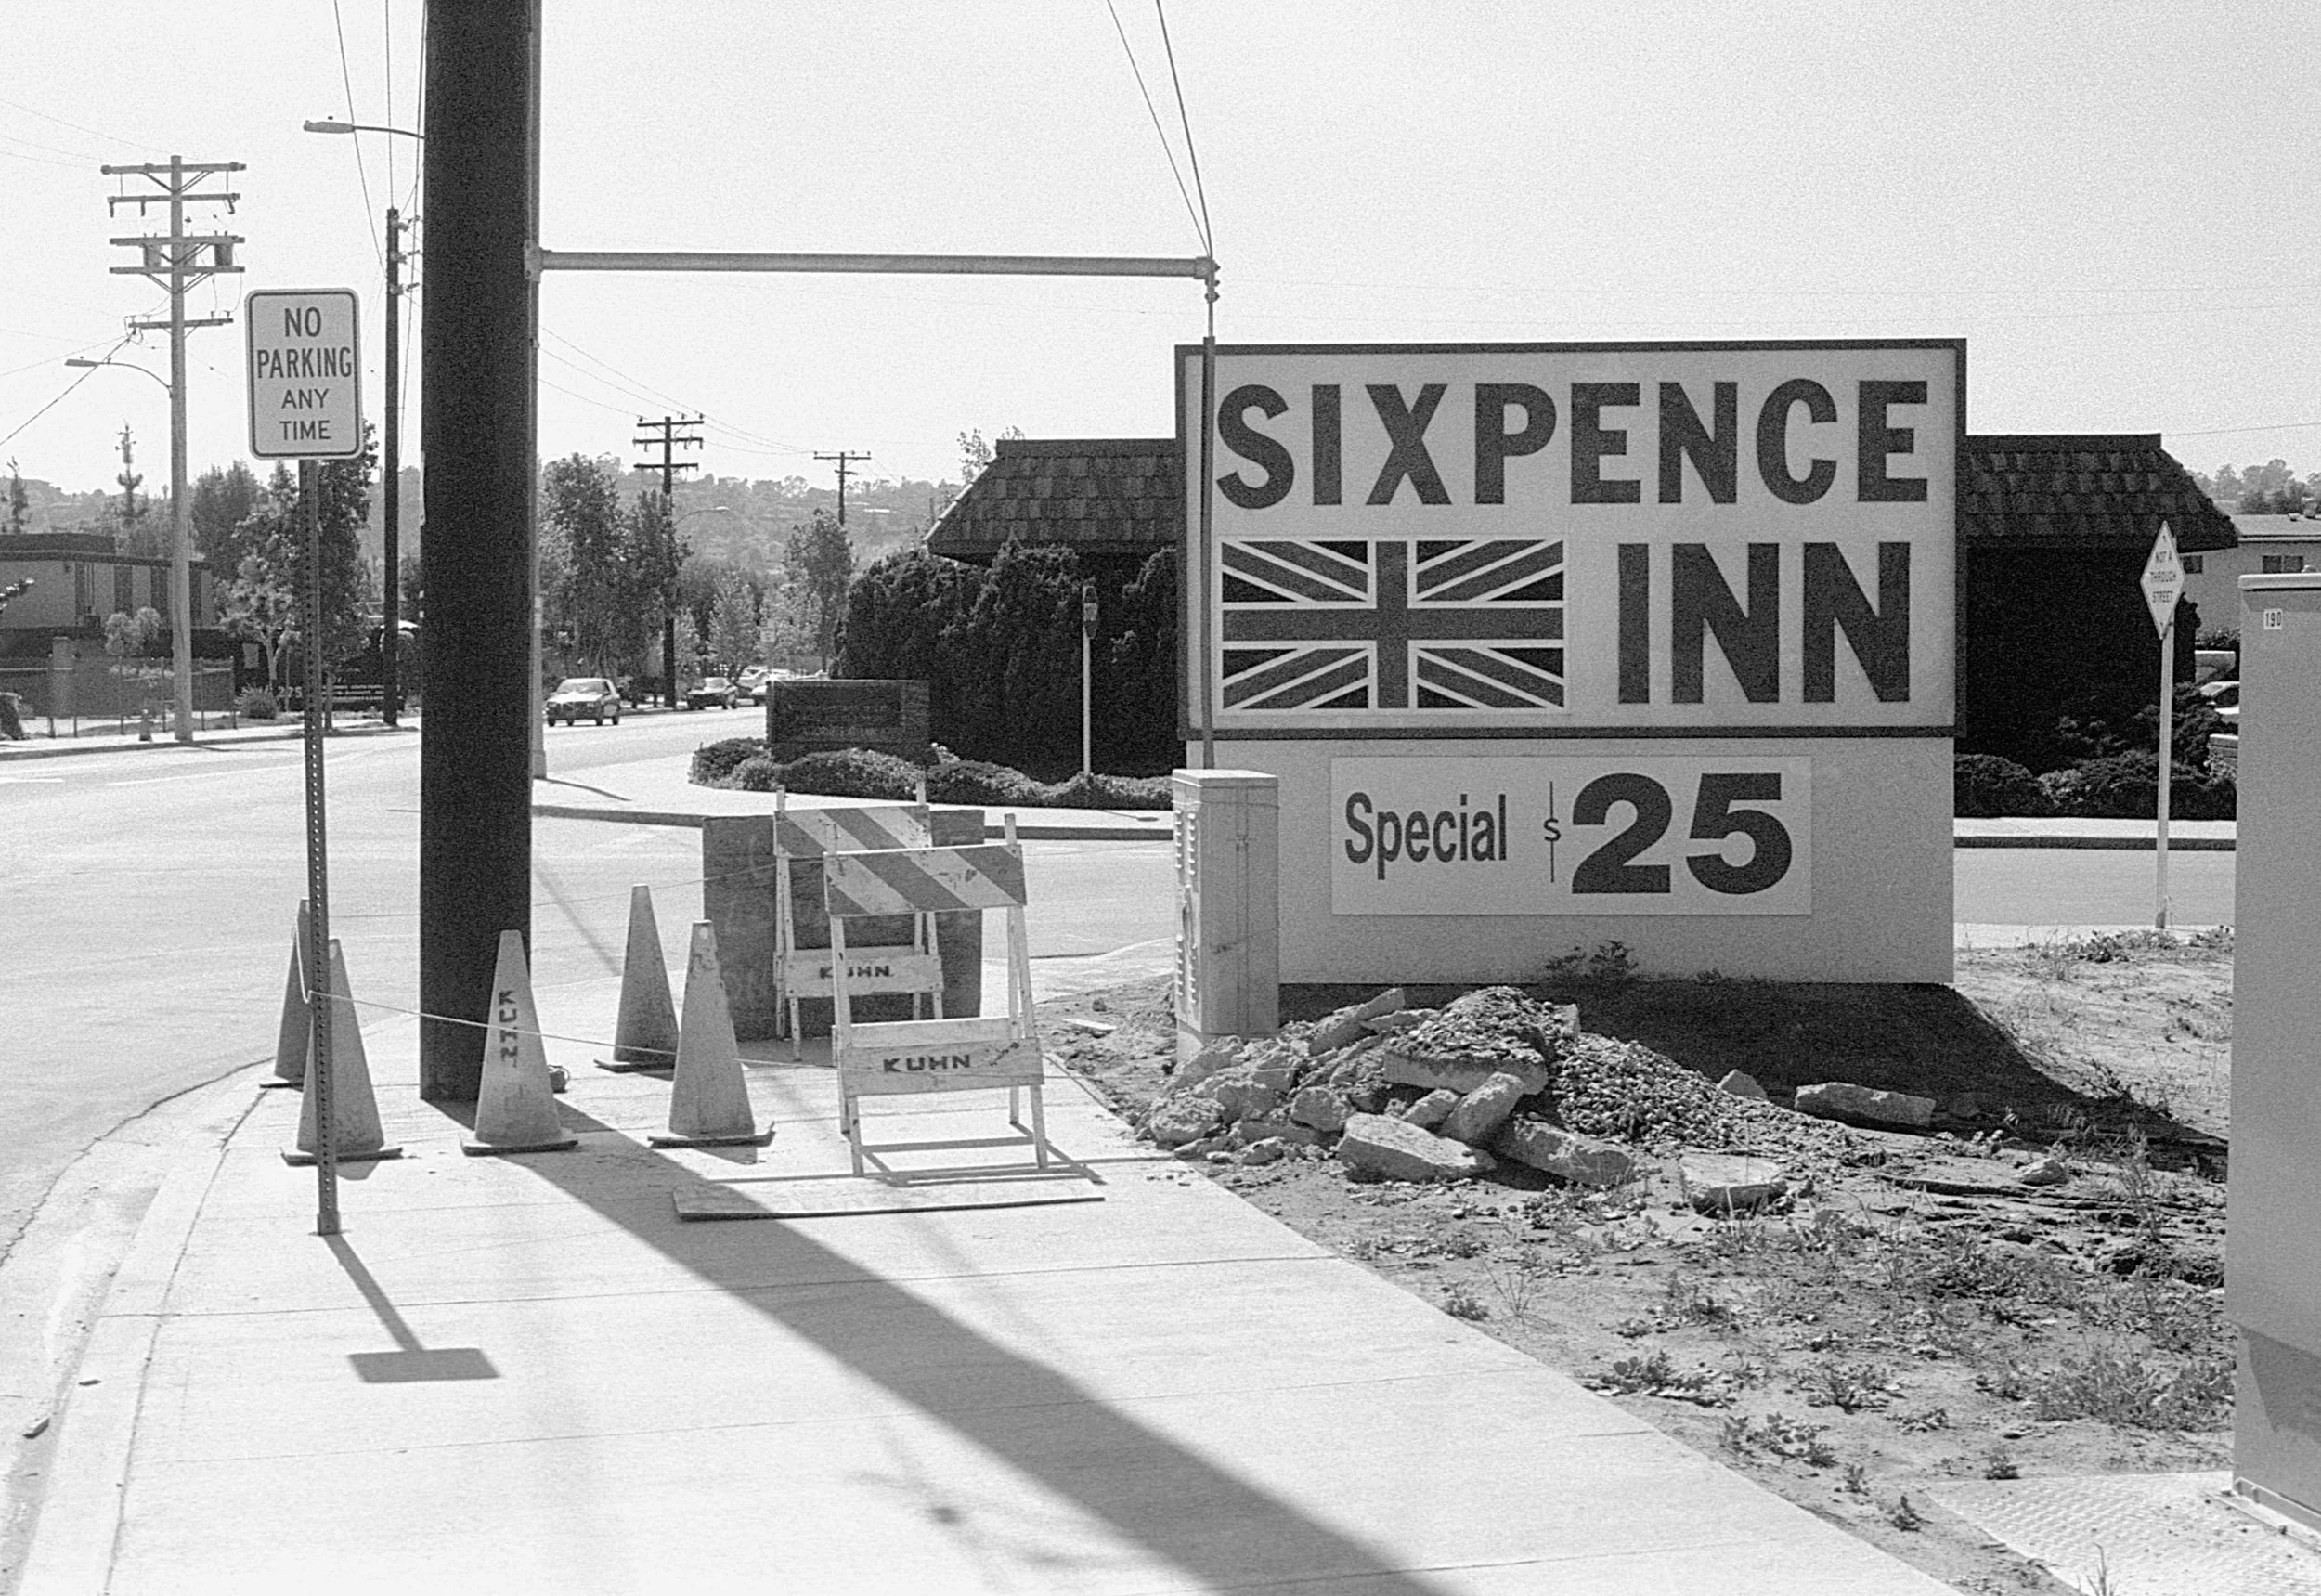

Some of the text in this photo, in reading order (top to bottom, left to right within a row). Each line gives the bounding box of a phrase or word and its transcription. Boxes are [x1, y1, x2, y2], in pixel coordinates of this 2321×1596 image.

[284, 306, 322, 337] NO
[257, 346, 353, 379] PARKING
[281, 388, 330, 409] ANY
[279, 420, 331, 441] TIME
[1216, 378, 1928, 510] SIXPENCE
[2155, 551, 2167, 564] NOT
[2152, 590, 2173, 603] STREET
[1618, 541, 1911, 705] INN
[2265, 611, 2282, 627] 190
[1344, 791, 1507, 880] Special
[499, 990, 518, 1069] KUHN
[883, 1055, 971, 1073] KUHN
